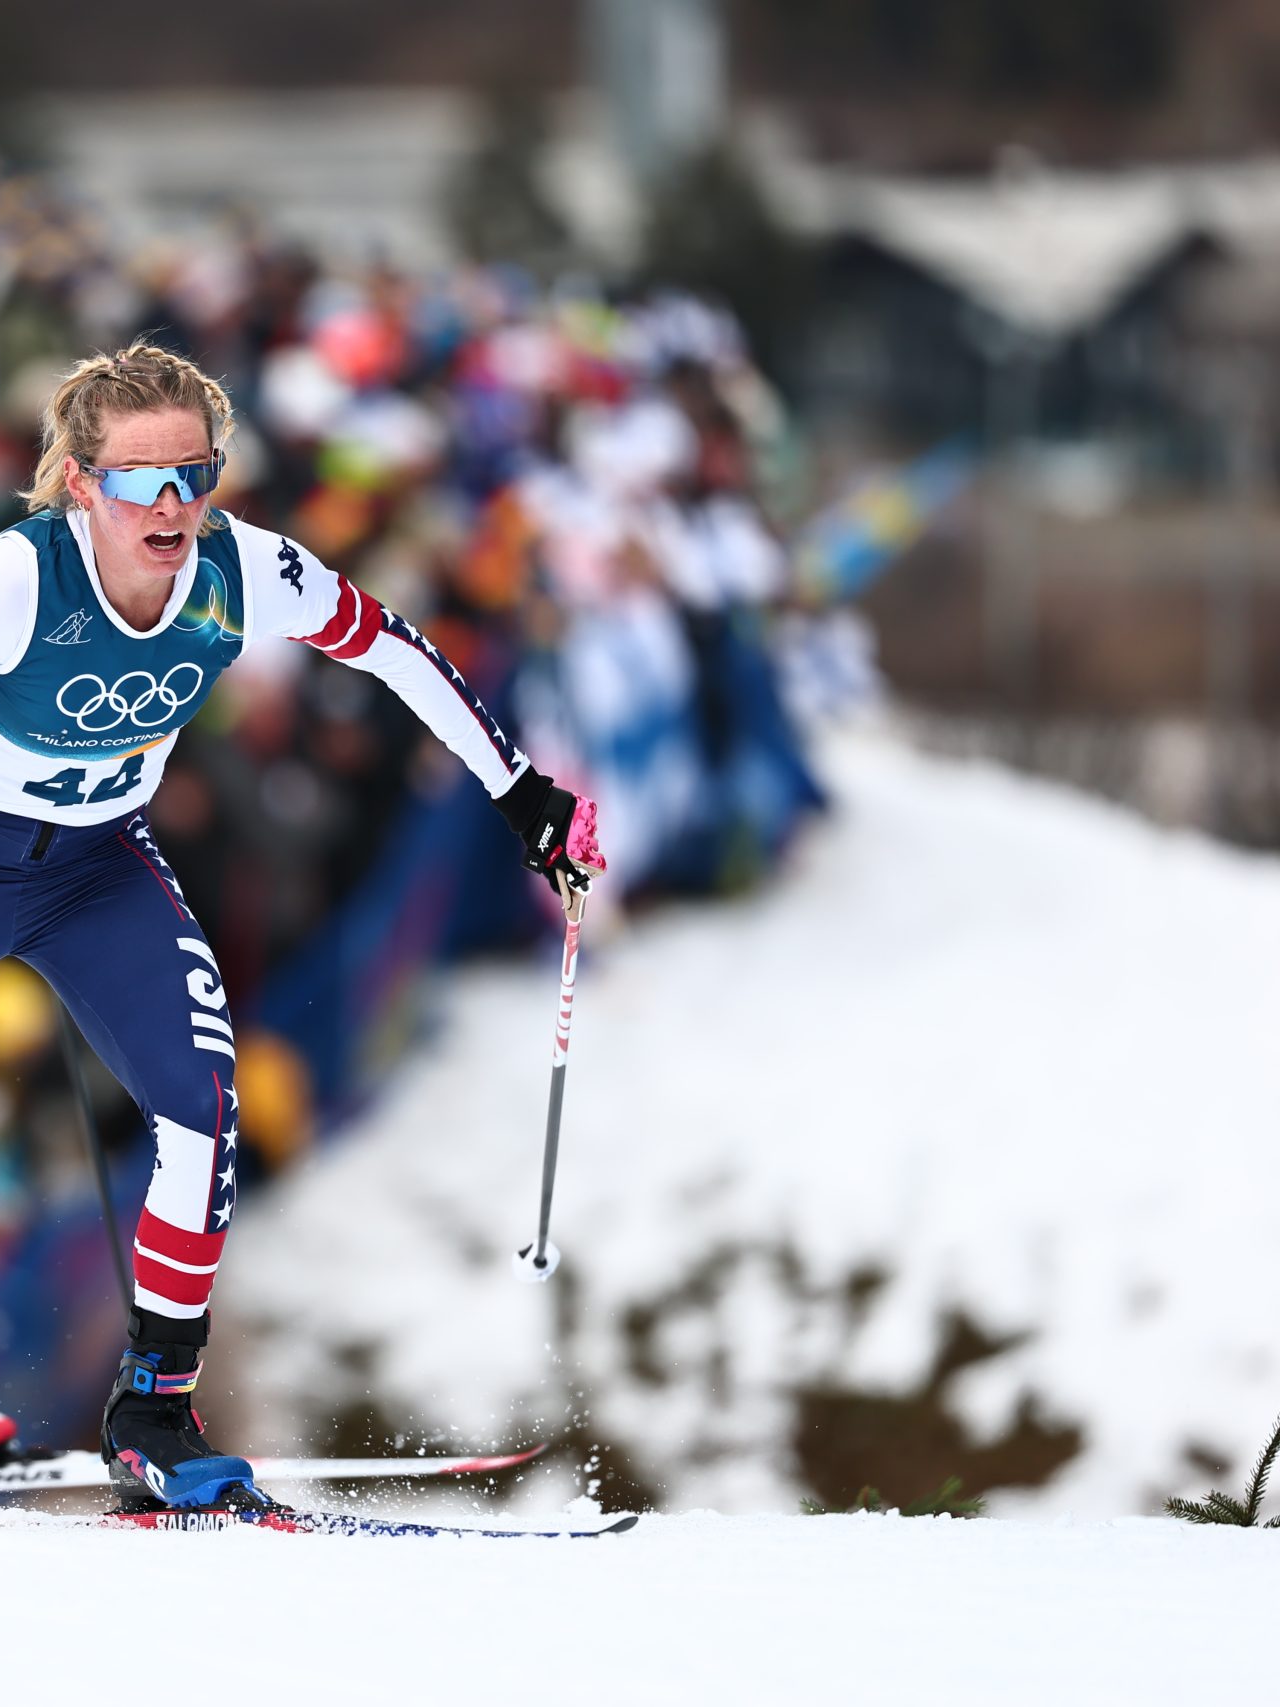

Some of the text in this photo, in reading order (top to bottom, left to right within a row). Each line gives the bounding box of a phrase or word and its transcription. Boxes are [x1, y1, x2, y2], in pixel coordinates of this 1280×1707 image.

[26, 732, 166, 747] MILANO CORTINA
[22, 752, 145, 807] 44
